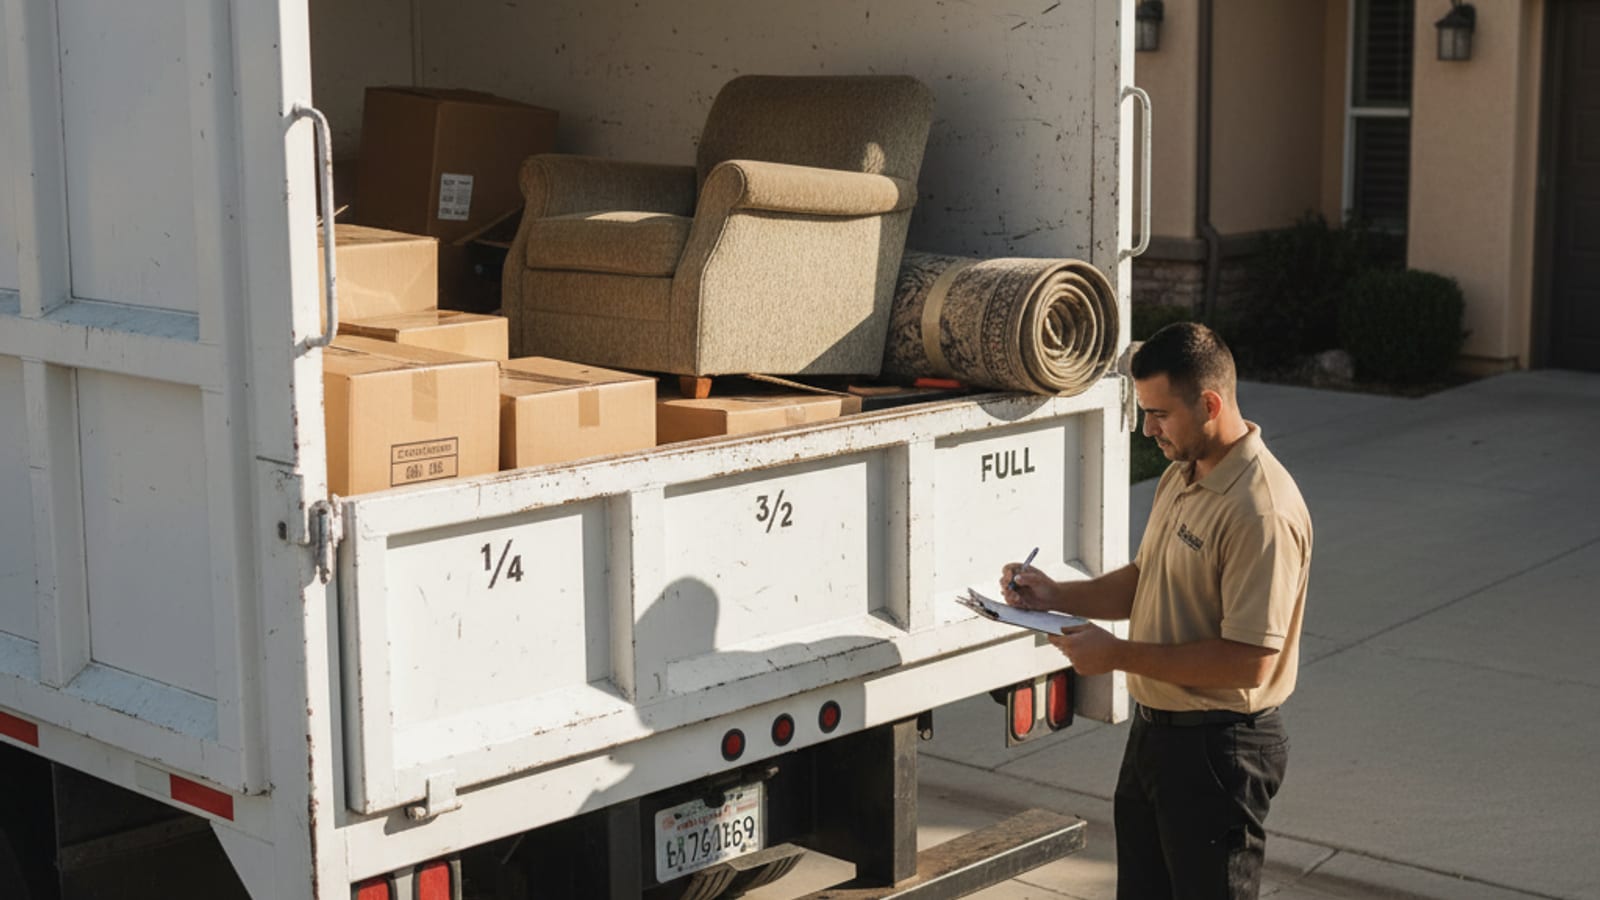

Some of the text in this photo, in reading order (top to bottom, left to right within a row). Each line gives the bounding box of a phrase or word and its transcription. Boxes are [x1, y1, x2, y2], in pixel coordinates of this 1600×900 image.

[981, 447, 1036, 482] FULL
[756, 489, 793, 533] 3/2
[480, 539, 524, 590] 1/4
